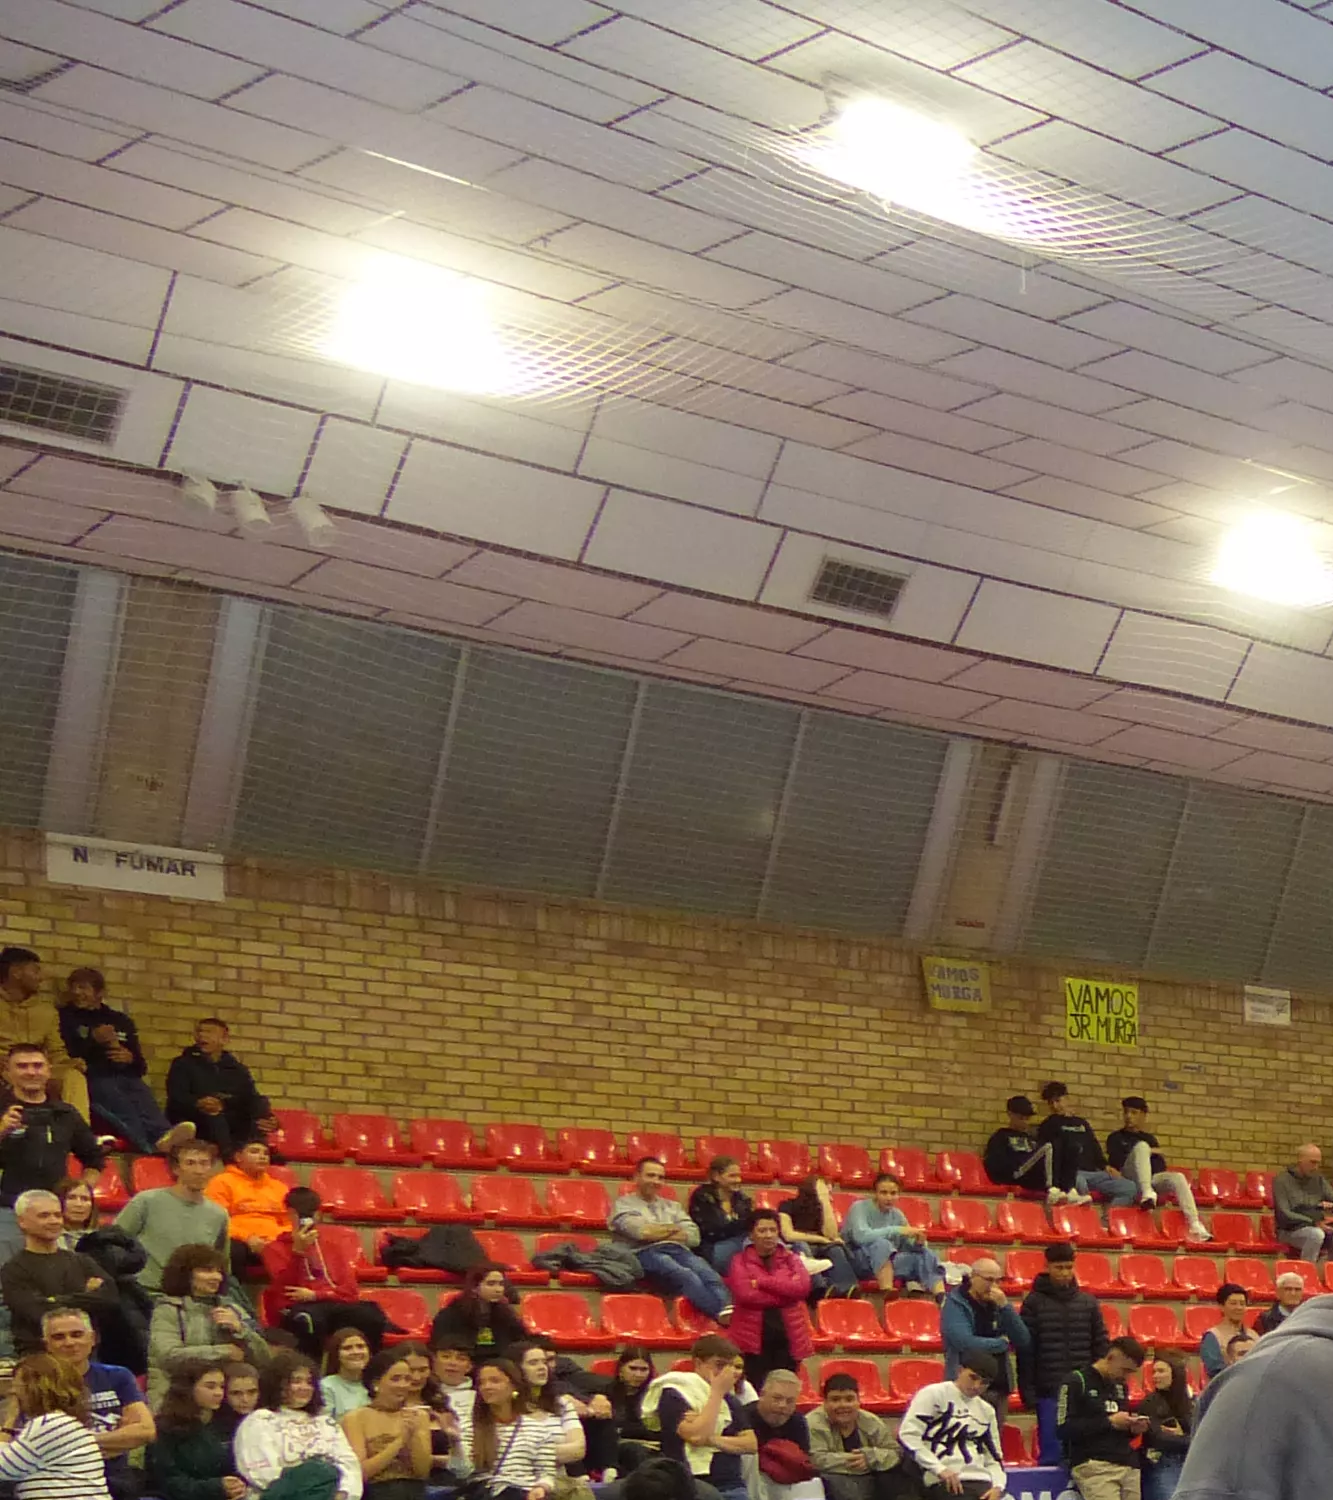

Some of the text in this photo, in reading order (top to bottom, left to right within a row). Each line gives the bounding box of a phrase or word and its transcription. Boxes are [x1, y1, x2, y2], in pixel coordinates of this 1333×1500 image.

[115, 851, 196, 877] FUMAR
[1068, 983, 1135, 1018] VAMOS
[1097, 1016, 1137, 1045] MURGA
